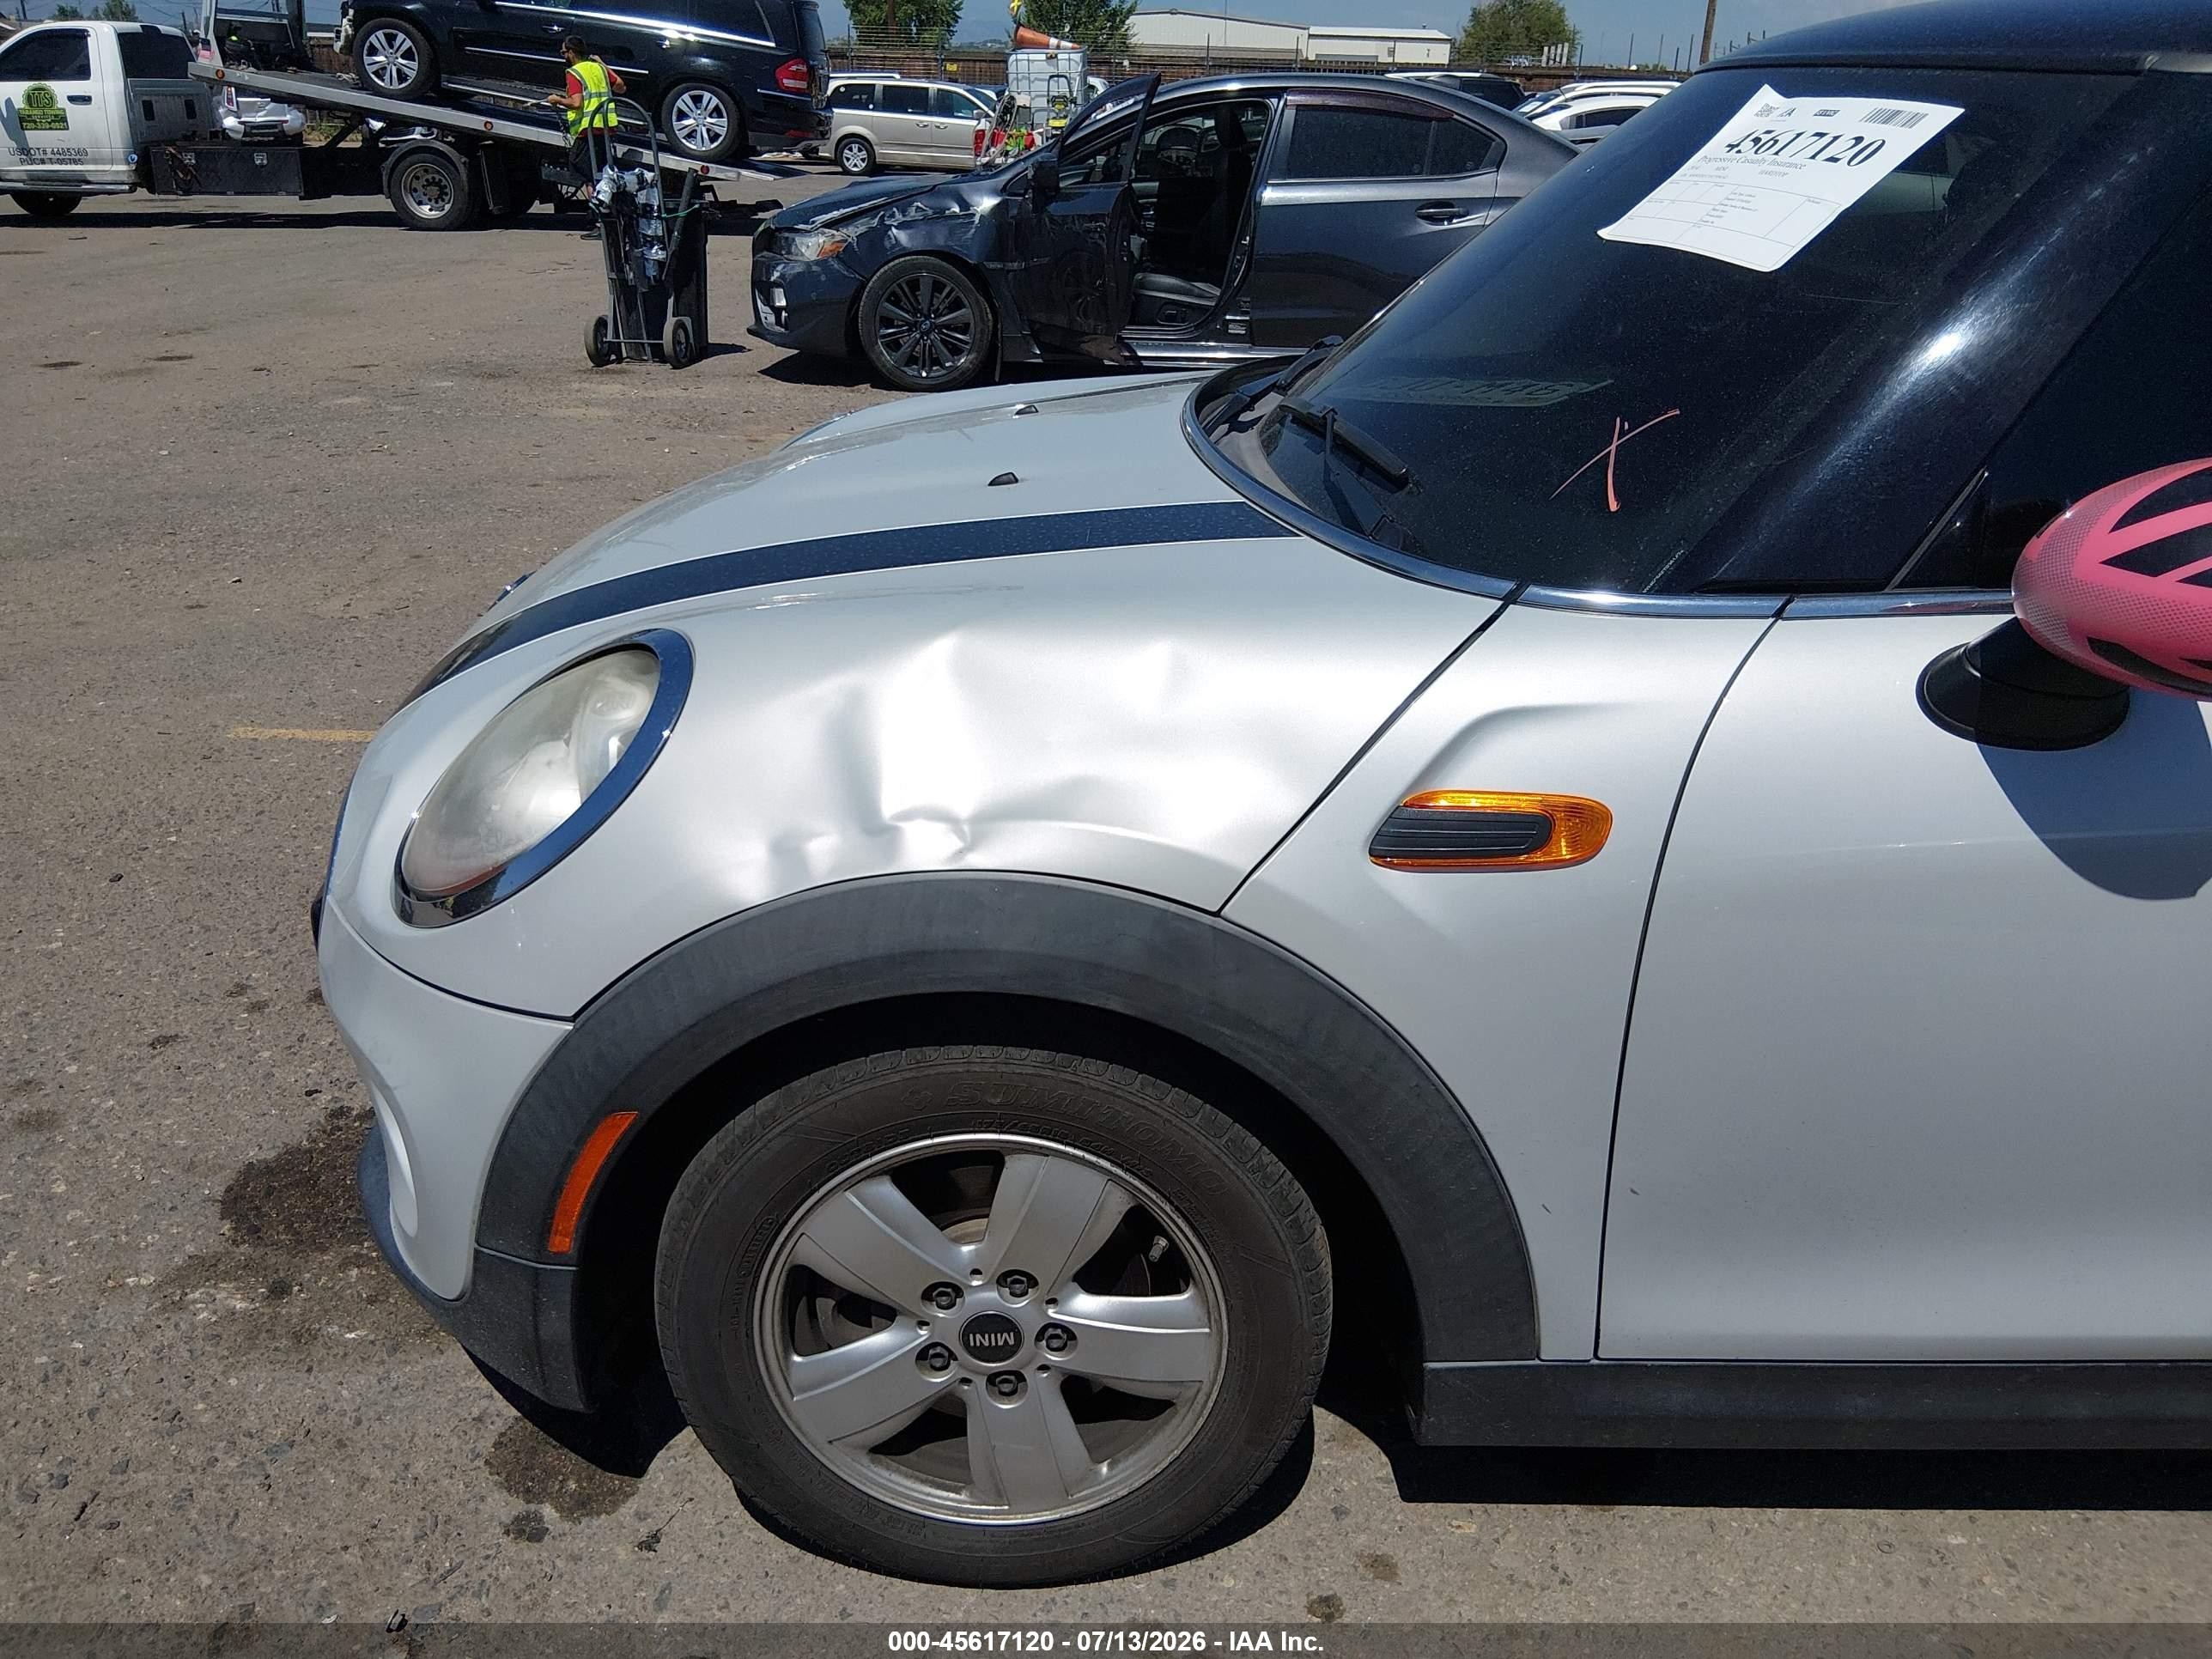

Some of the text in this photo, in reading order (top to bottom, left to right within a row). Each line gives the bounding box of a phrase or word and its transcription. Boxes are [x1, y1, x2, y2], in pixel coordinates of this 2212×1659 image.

[29, 91, 52, 107] TTS
[8, 147, 89, 156] USDOT# 4485369
[1724, 128, 1887, 167] 45617120
[19, 157, 46, 166] PUC#
[1766, 158, 1807, 170] Insurance
[945, 1080, 1231, 1196] SUMITOMO
[969, 1332, 1015, 1346] MINI
